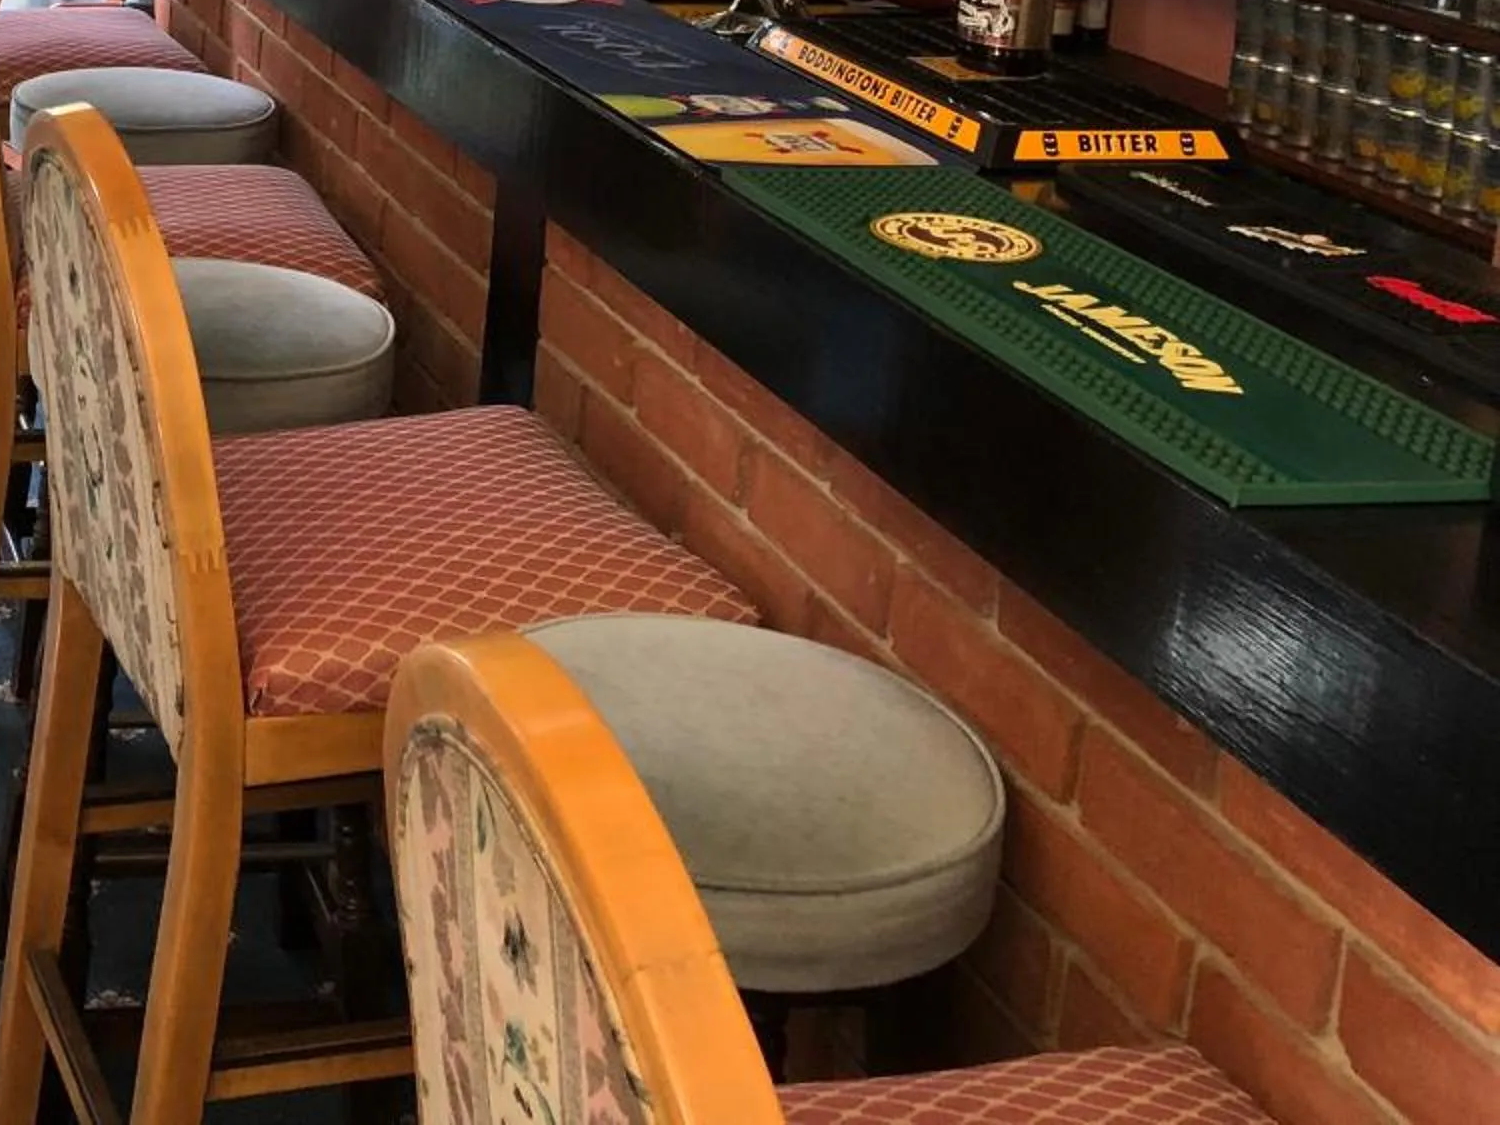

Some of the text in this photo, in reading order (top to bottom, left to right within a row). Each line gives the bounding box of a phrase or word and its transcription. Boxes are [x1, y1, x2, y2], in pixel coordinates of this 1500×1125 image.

[798, 42, 938, 125] BODDINGTONS BITTER
[1077, 134, 1158, 154] BITTER
[1012, 279, 1245, 395] JAMESON
